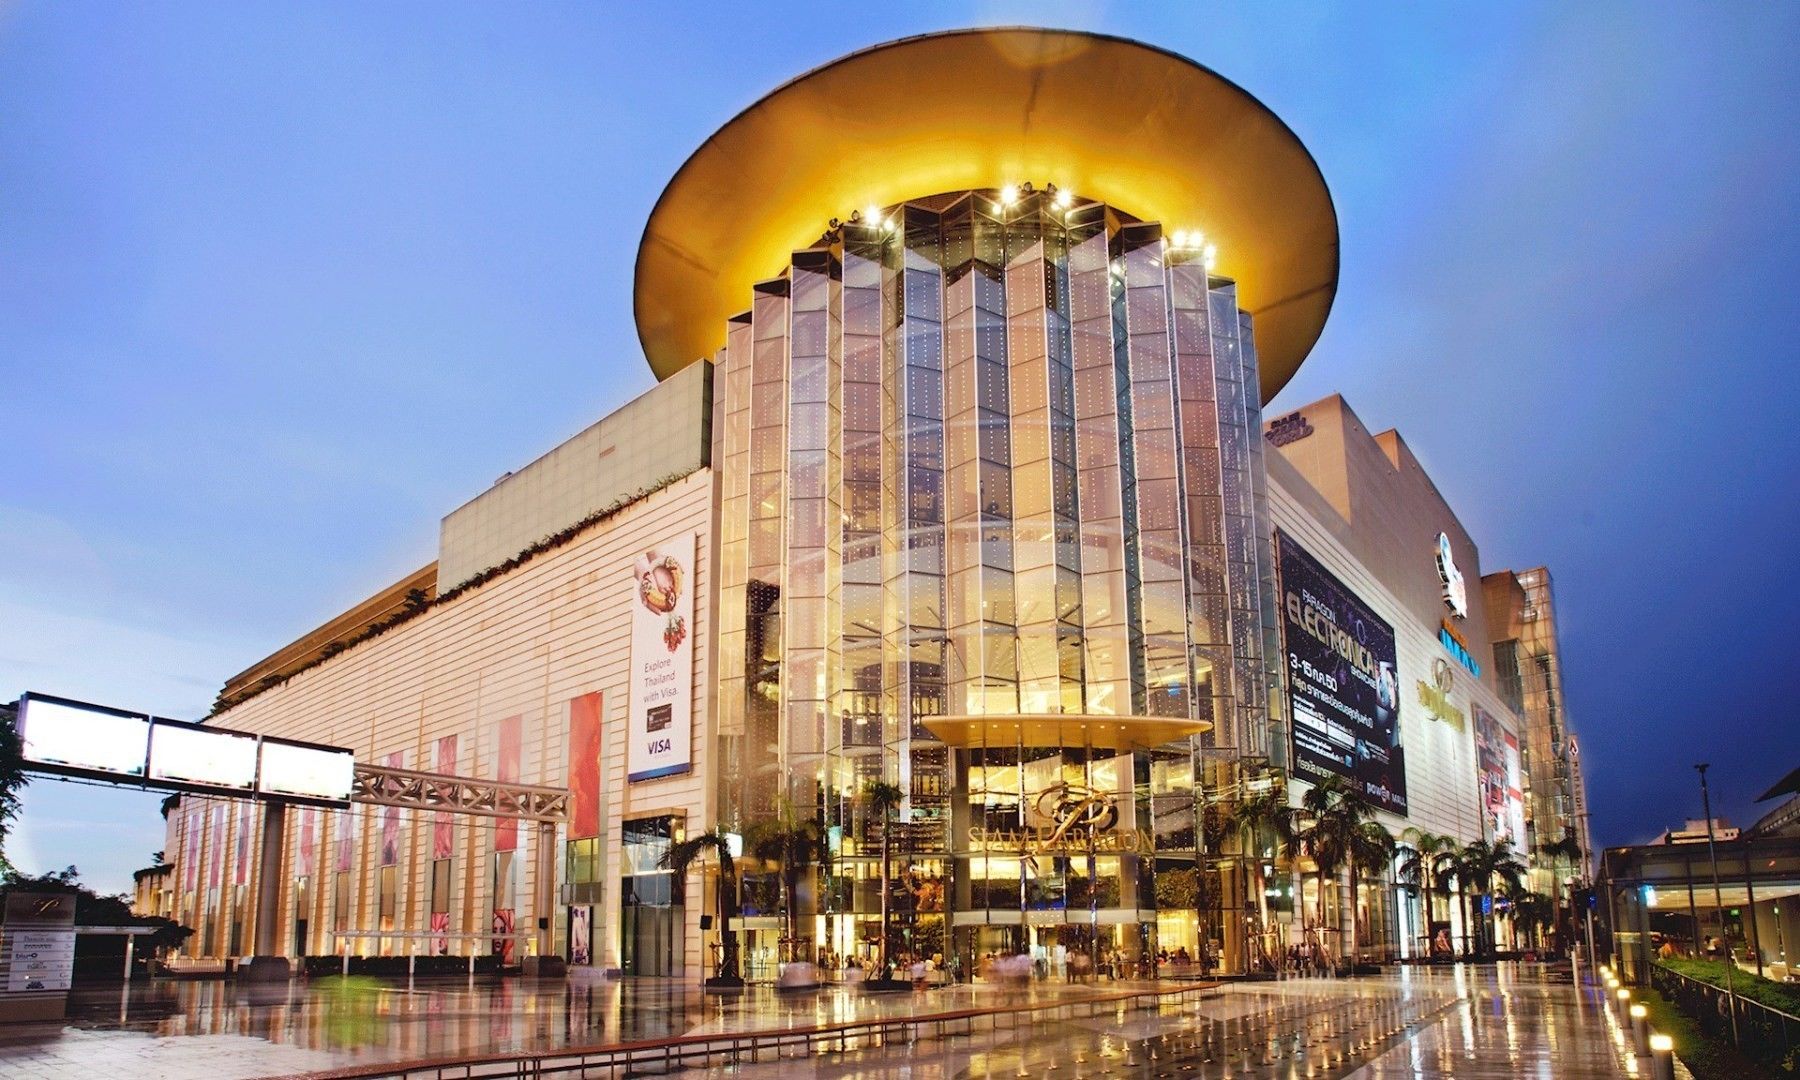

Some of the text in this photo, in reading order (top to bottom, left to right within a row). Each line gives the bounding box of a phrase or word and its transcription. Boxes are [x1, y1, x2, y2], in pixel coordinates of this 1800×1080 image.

[1302, 589, 1336, 623] PARAGON
[1286, 592, 1375, 678] ELECTRONICA
[644, 657, 672, 674] Explore
[644, 670, 676, 687] Thailand
[643, 690, 659, 704] with
[647, 738, 671, 755] VISA
[967, 824, 1156, 855] SIAM PARAGON
